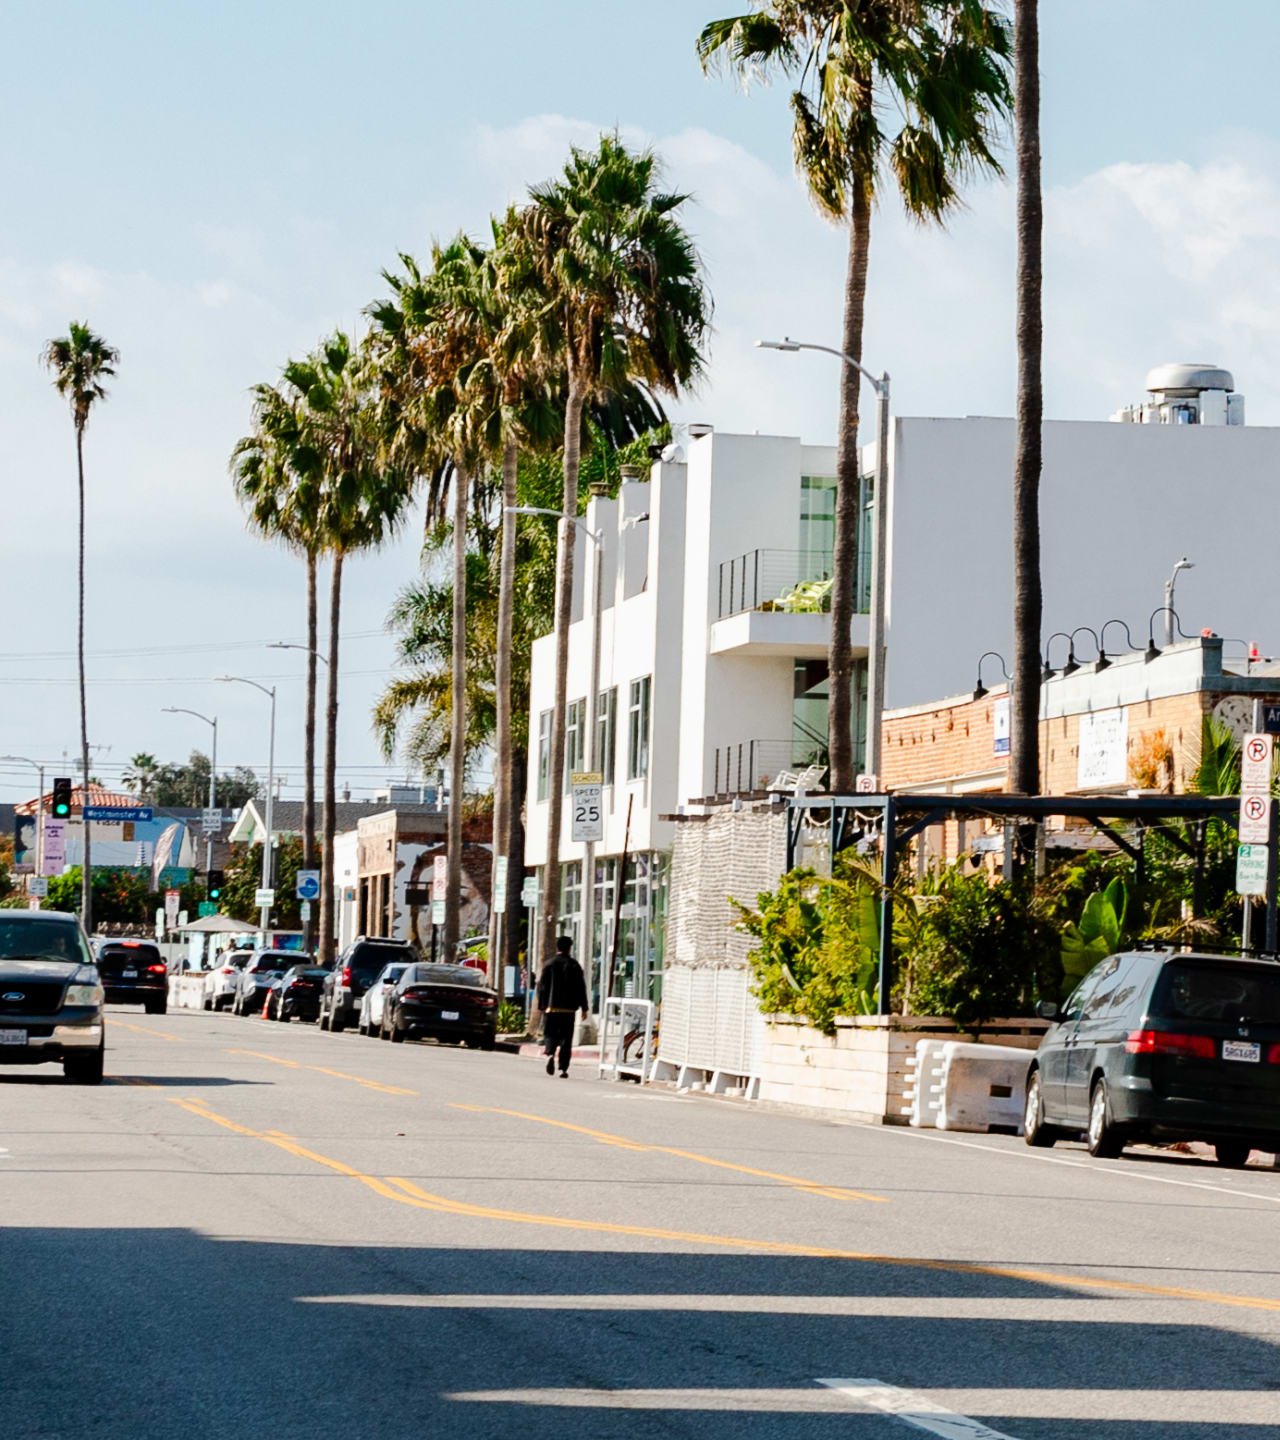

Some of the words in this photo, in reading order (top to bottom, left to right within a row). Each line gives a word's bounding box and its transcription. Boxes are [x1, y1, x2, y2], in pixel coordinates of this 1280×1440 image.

[575, 788, 600, 796] SPEED
[577, 797, 597, 805] LIMIT
[88, 810, 136, 819] Westminster
[576, 806, 600, 822] 25
